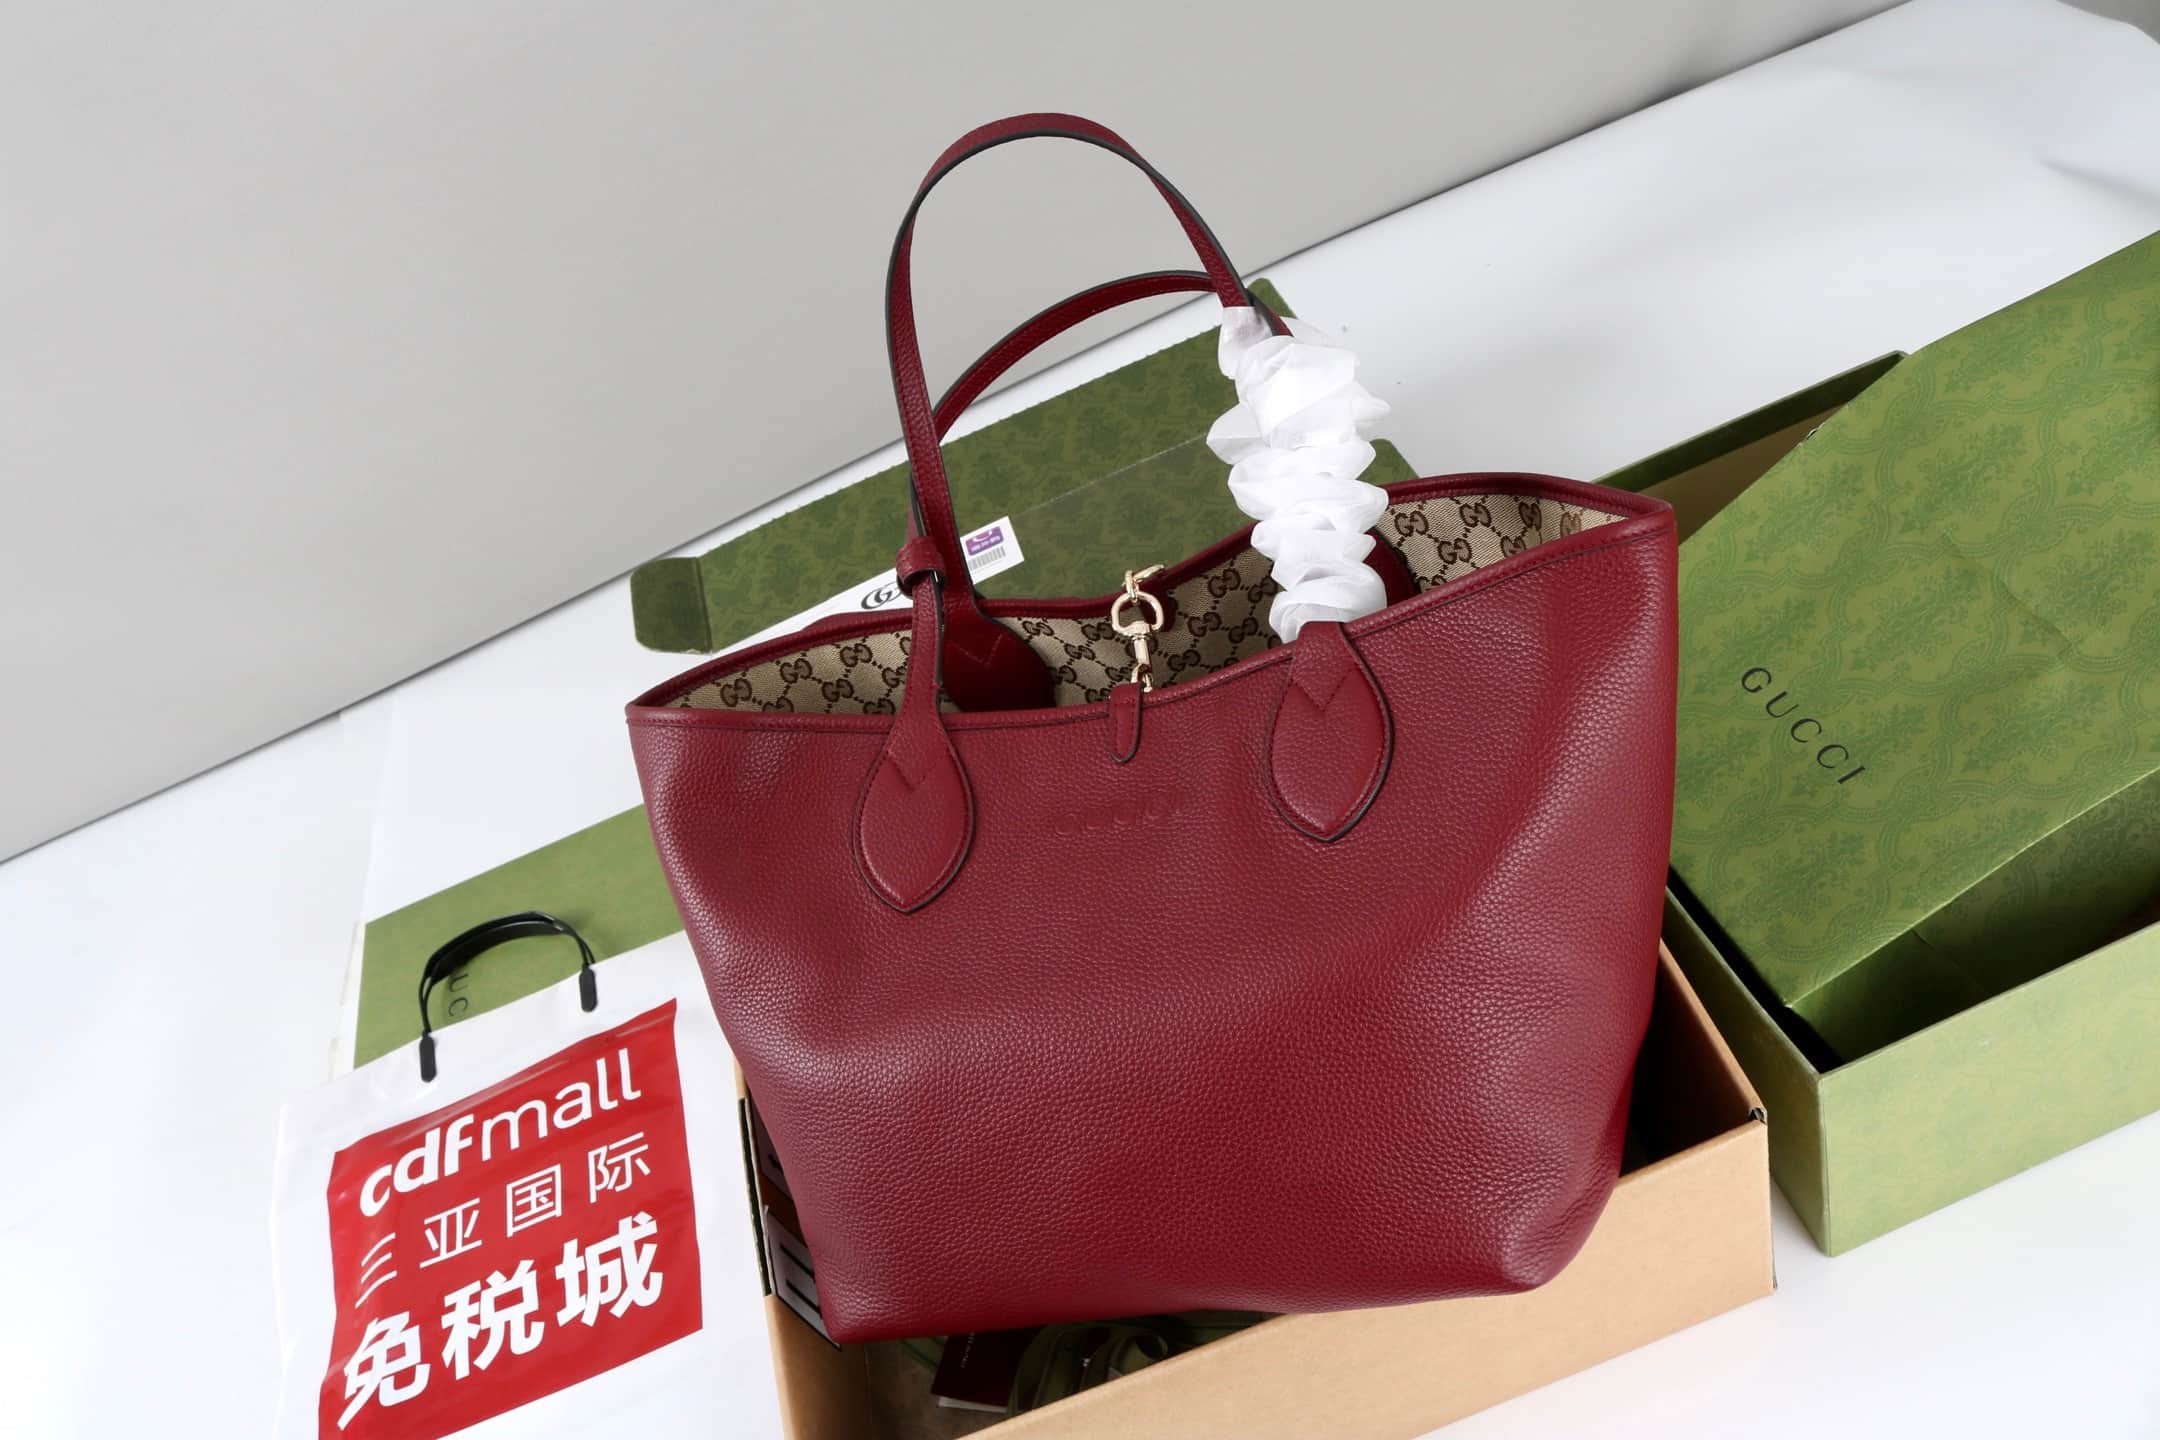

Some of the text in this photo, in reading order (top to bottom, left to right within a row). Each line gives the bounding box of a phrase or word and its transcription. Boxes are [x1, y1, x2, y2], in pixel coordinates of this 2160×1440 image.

[1741, 667, 1866, 784] GUCCI
[359, 1048, 642, 1217] cdfmall
[355, 1131, 651, 1308] 三亚国际
[336, 1211, 663, 1430] 免税城
